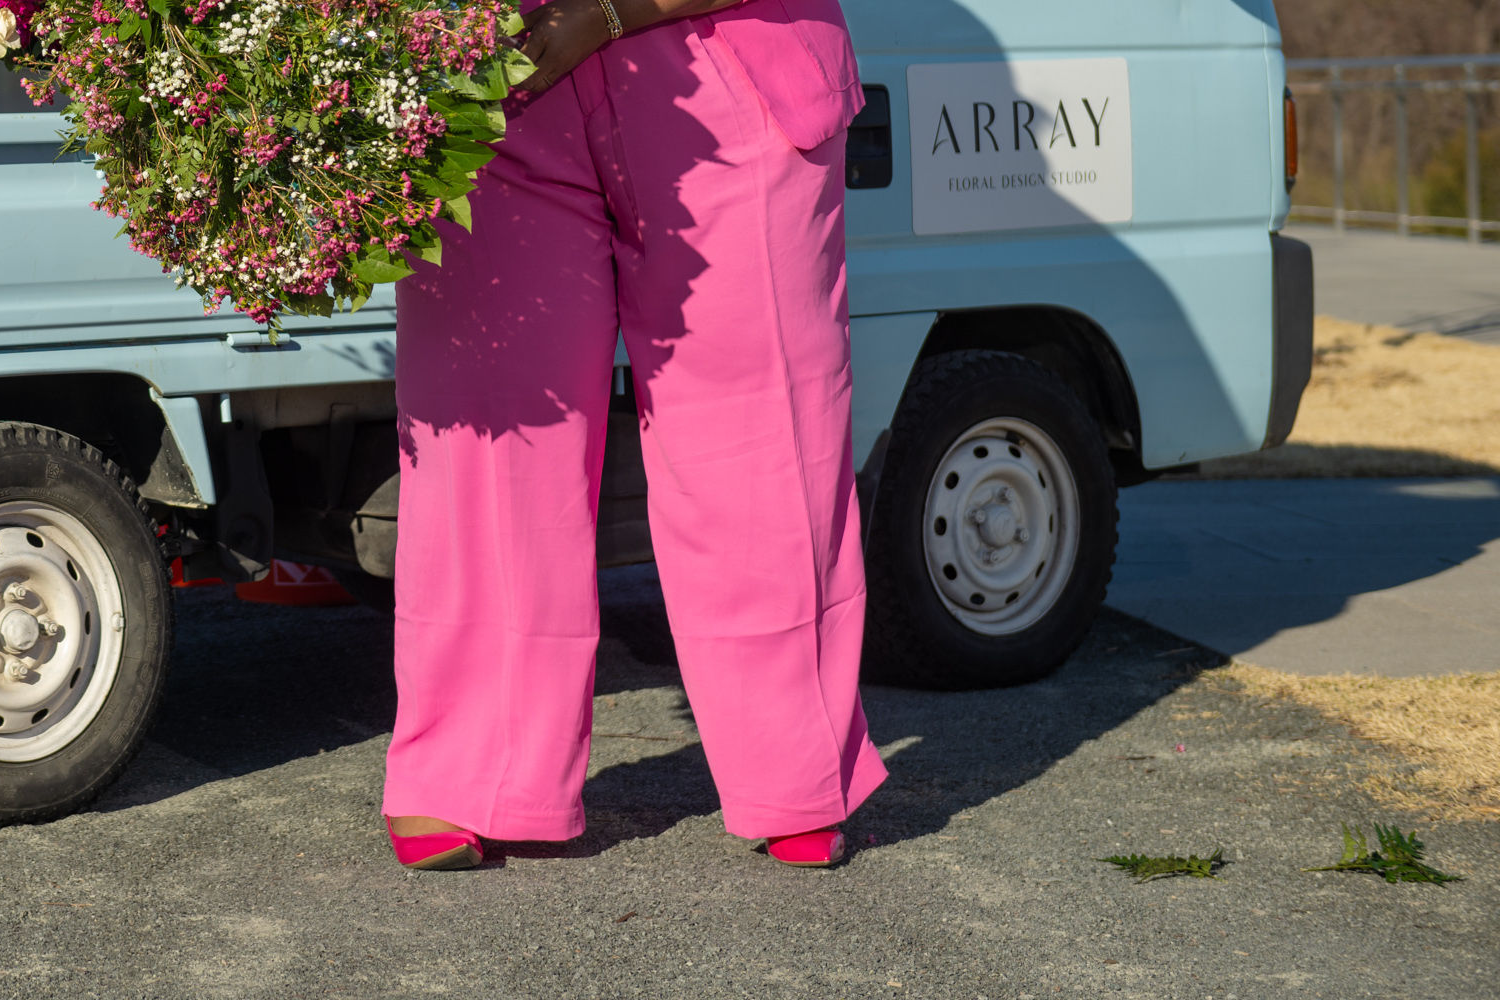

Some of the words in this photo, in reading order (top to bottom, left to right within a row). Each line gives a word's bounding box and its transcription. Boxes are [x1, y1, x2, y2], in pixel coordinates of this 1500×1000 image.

[931, 96, 1109, 156] ARRAY
[949, 175, 996, 193] FLORAL
[1001, 172, 1046, 190] DESIGN
[1051, 170, 1097, 186] STUDIO
